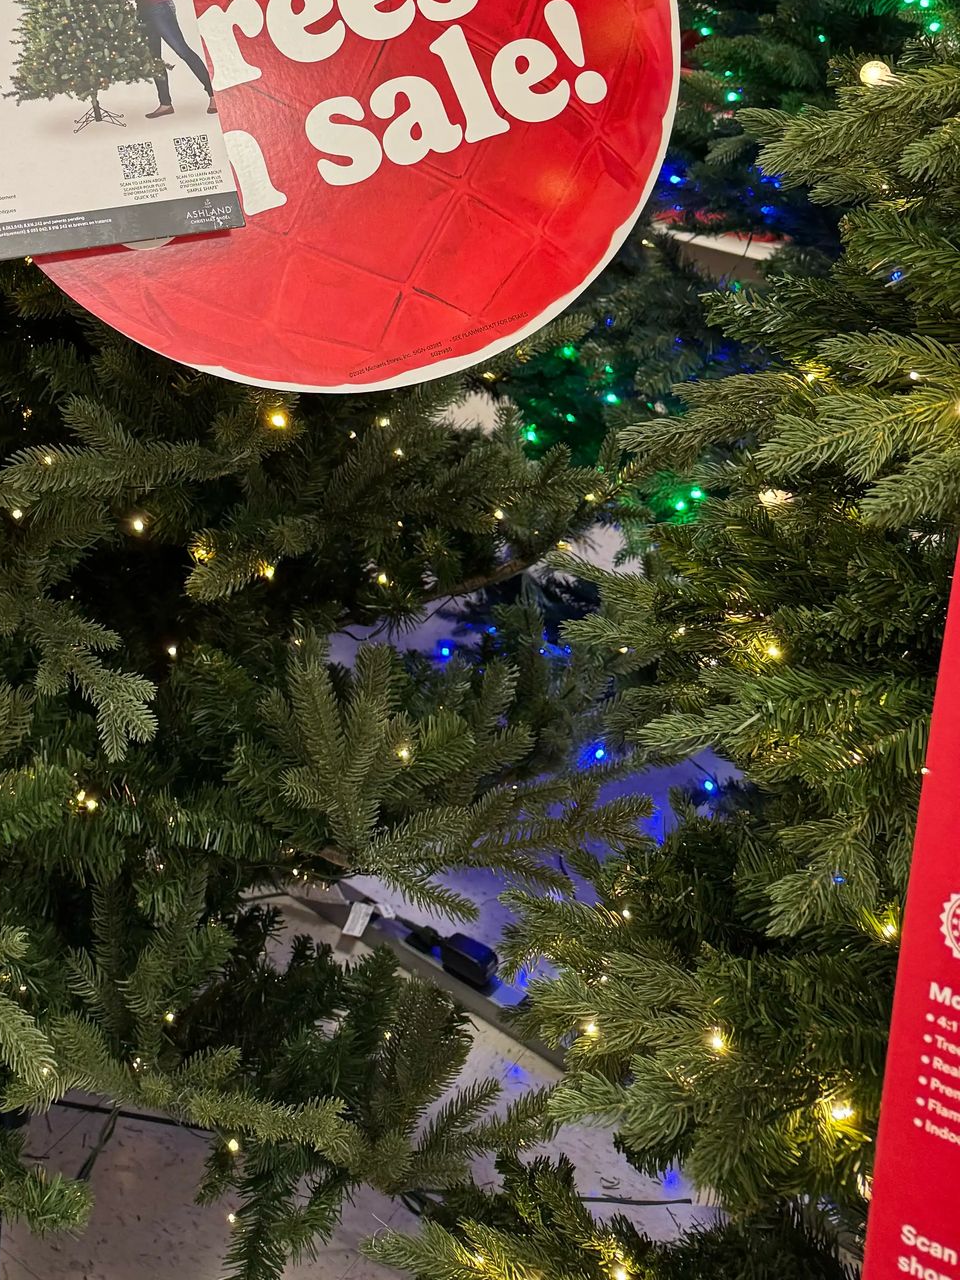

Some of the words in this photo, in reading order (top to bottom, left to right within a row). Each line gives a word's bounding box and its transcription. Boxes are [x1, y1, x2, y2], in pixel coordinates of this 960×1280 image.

[305, 0, 608, 188] sale!
[186, 206, 231, 219] ASHLAND
[929, 982, 960, 1010] Mo
[928, 1098, 960, 1123] Flam
[925, 1119, 960, 1145] Indo
[901, 1224, 957, 1266] Scan
